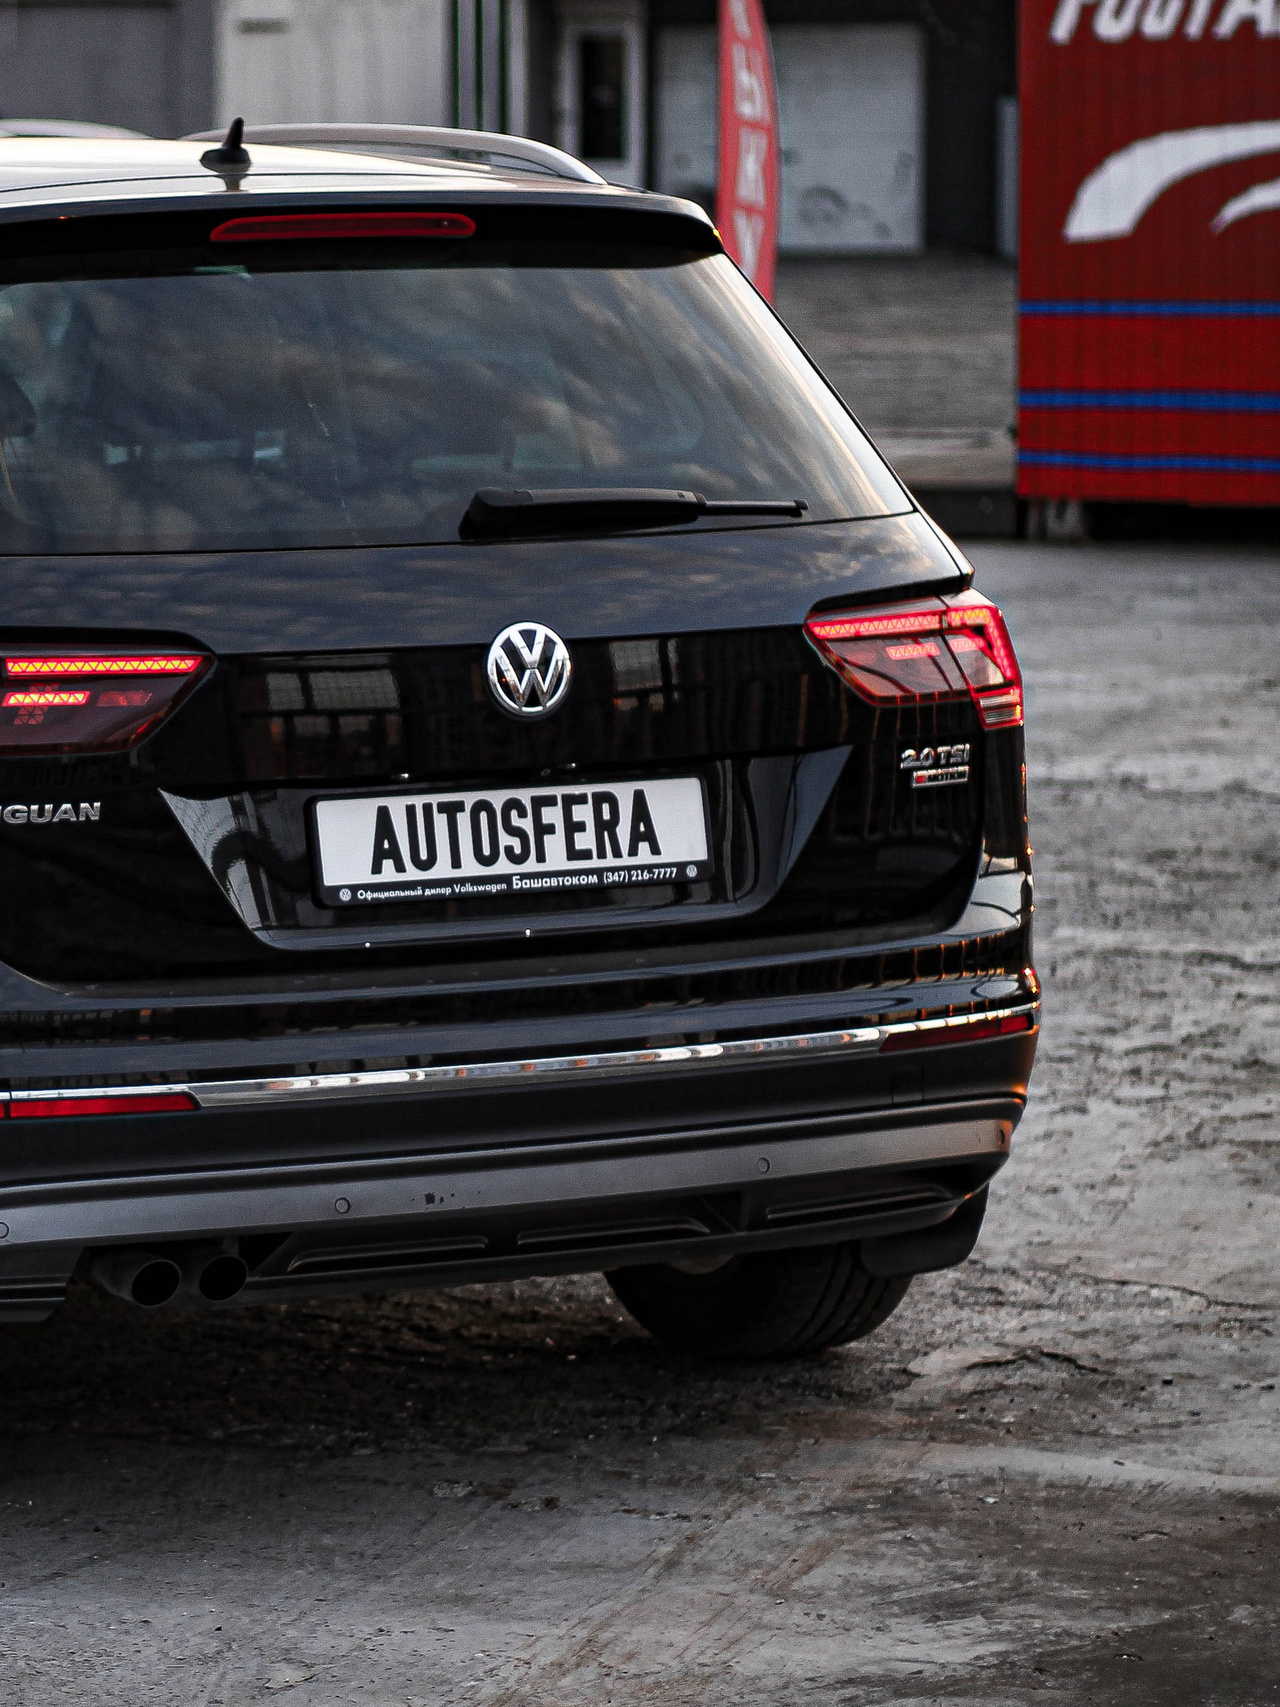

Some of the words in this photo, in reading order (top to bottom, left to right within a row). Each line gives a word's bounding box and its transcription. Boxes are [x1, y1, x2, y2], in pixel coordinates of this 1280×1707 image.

[937, 743, 971, 766] TSI
[370, 788, 662, 875] AUTOSFERA
[357, 886, 423, 900] Официальный
[424, 887, 452, 897] дилер
[453, 881, 508, 893] Volkswagen
[512, 875, 599, 889] Башавтоком
[603, 870, 629, 884] (347)
[630, 867, 678, 881] 216-7777
